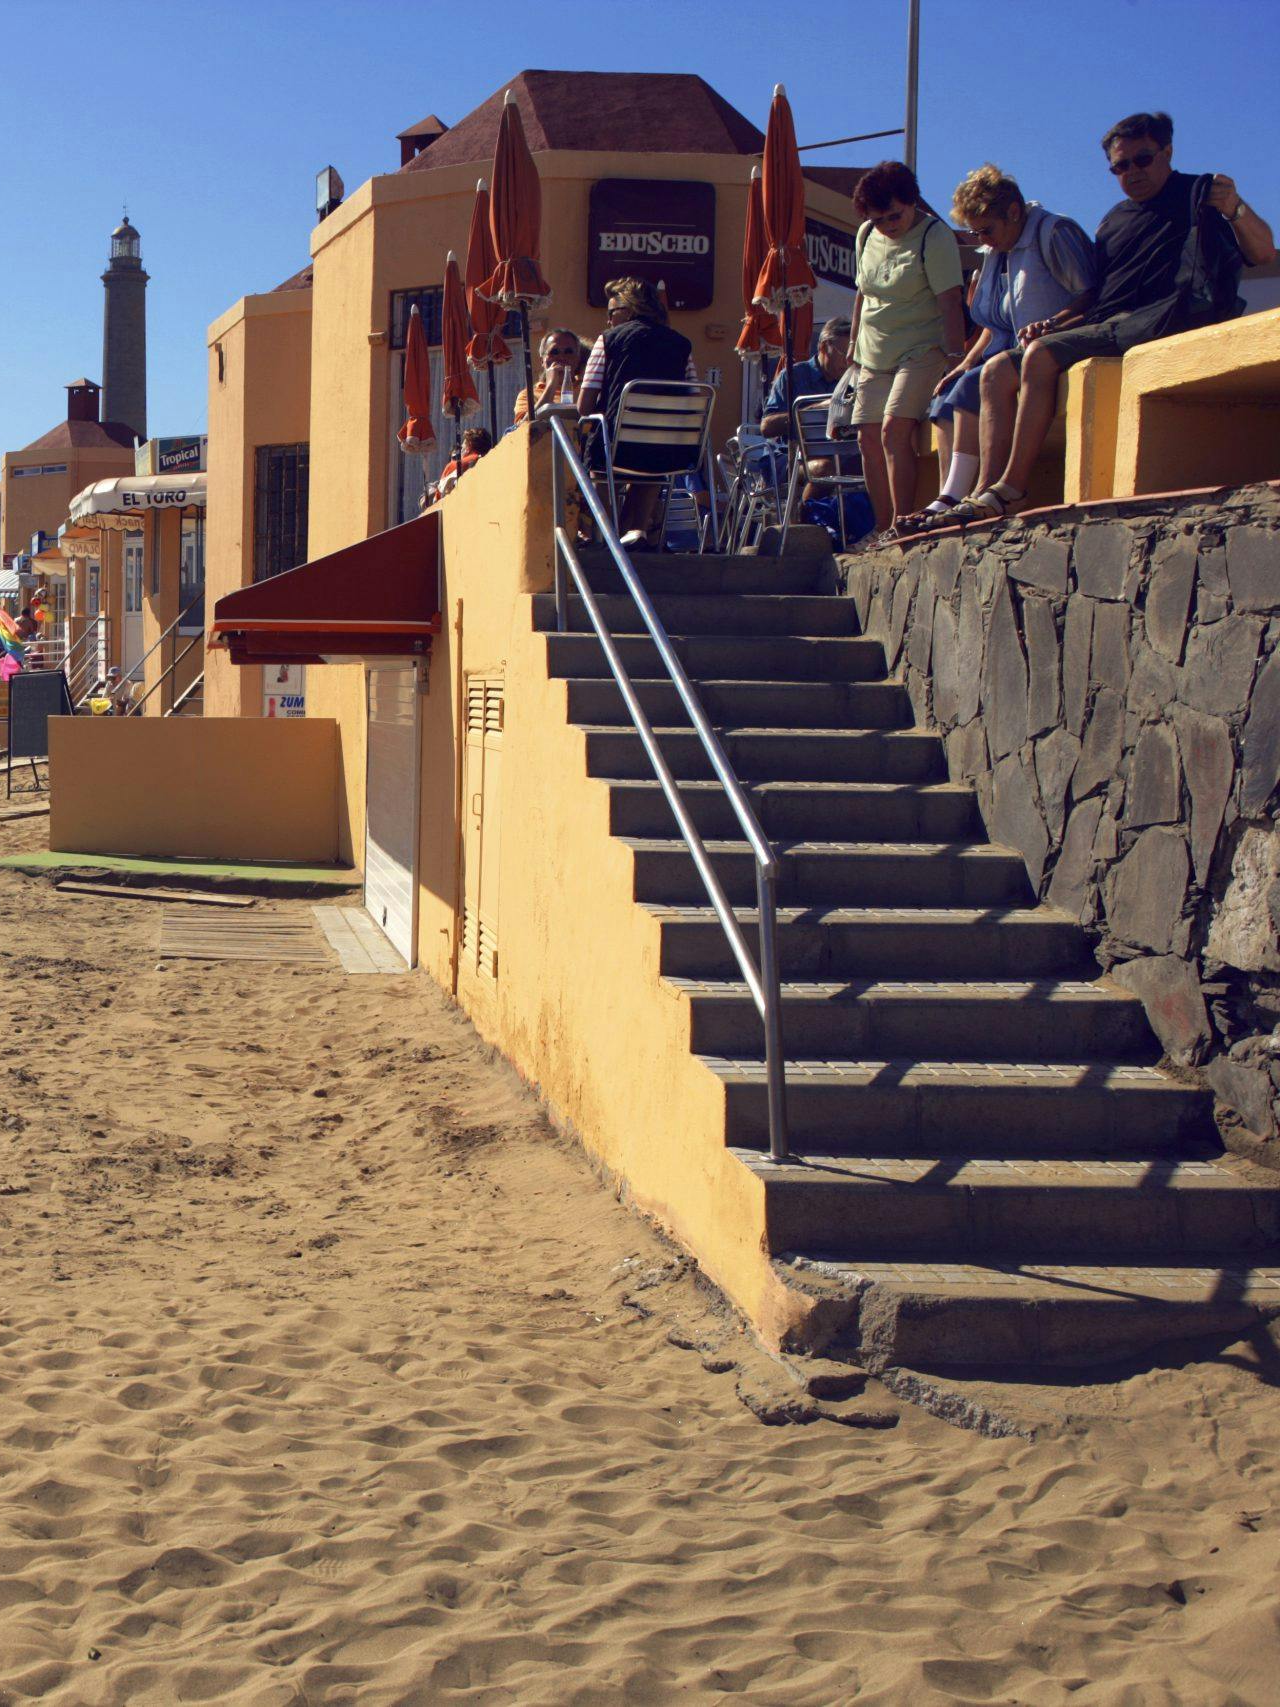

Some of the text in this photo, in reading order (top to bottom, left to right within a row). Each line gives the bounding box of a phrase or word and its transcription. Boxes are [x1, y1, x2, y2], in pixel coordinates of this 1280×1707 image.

[160, 446, 199, 467] Tropical
[122, 490, 186, 506] EL TORO
